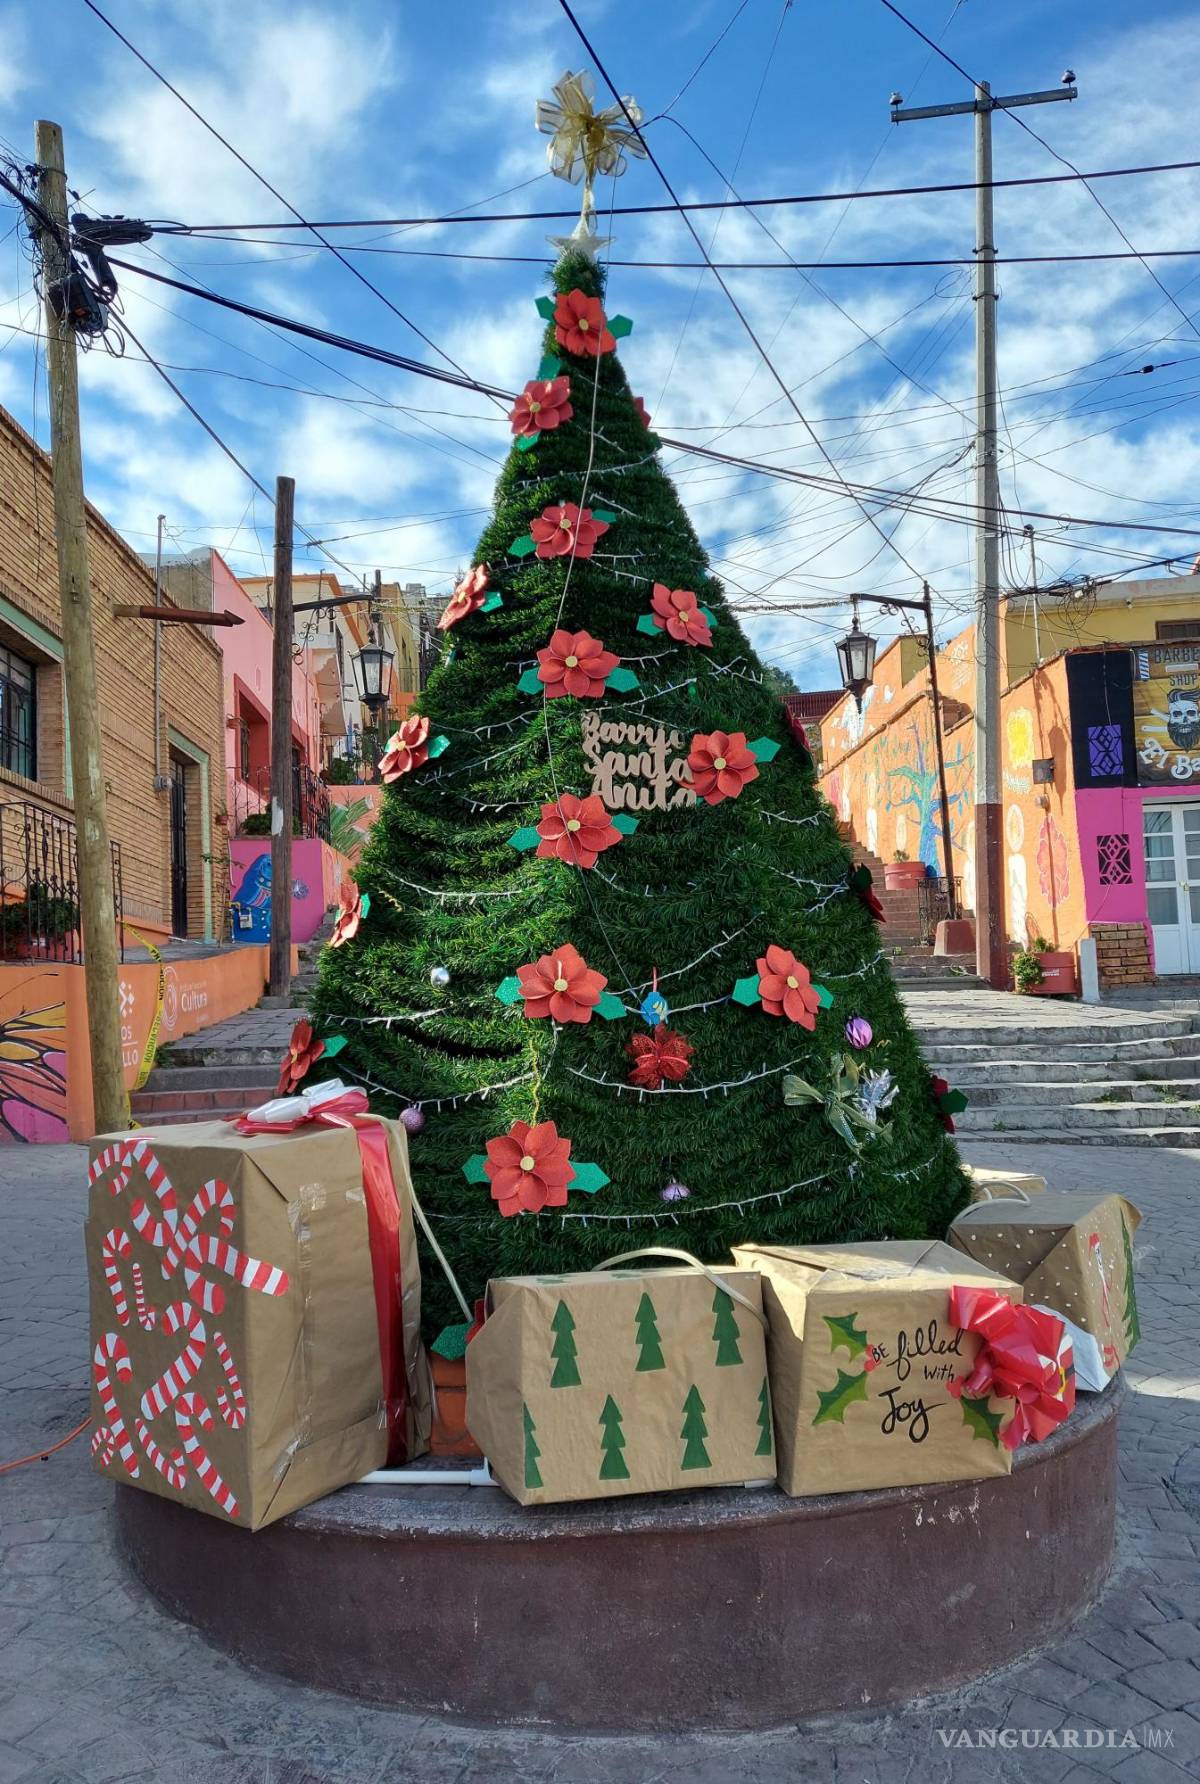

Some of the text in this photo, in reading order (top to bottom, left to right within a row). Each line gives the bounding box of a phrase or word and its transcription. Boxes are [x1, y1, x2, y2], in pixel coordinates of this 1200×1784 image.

[1169, 674, 1198, 687] SHOP
[581, 712, 685, 750] Barrio
[582, 739, 695, 784] Santa
[590, 773, 697, 812] Anita
[181, 990, 208, 1013] Cultura
[871, 1319, 963, 1381] BE filled
[878, 1385, 947, 1443] Joy
